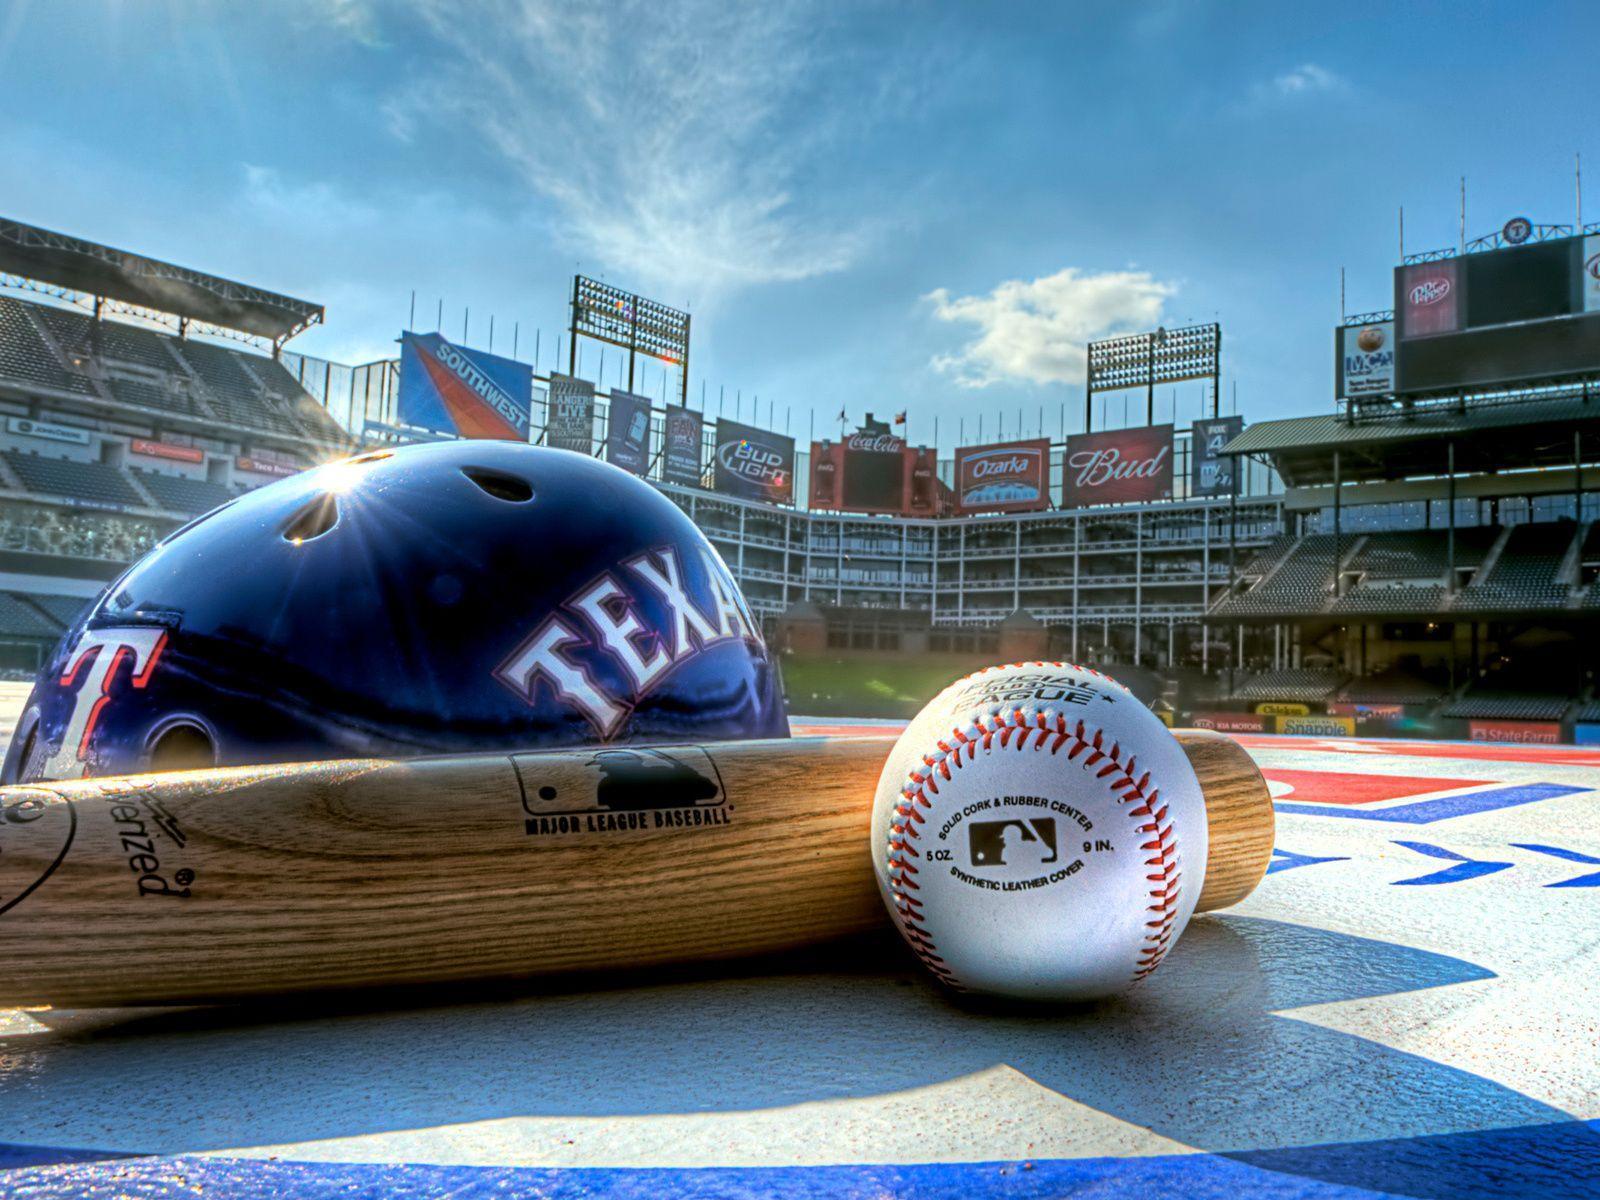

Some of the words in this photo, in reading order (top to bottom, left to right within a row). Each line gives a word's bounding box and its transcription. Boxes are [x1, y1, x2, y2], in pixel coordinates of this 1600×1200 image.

[436, 343, 528, 429] SOUTHWEST
[557, 403, 586, 417] LIVE
[253, 462, 273, 472] Taco
[735, 442, 783, 467] BUD
[973, 456, 1029, 478] Ozarka
[1069, 445, 1169, 488] Bud
[725, 456, 790, 481] LIGHT
[491, 543, 759, 744] TEXA
[44, 627, 169, 779] T
[1216, 722, 1230, 730] KIA
[1231, 723, 1263, 732] MOTORS
[1284, 718, 1347, 737] Snapple
[525, 816, 581, 835] MAJOR
[587, 812, 648, 832] LEAGUE
[654, 808, 731, 829] BASEBALL
[938, 812, 963, 841] SOLID
[963, 799, 992, 817] CORK
[993, 798, 1001, 808] &
[1003, 795, 1049, 809] RUBBER
[1050, 799, 1094, 833] CENTER
[926, 850, 934, 862] 5
[935, 850, 954, 862] OZ.
[1082, 841, 1092, 853] 9
[1095, 840, 1115, 852] IN.
[950, 866, 1001, 891] SYNTHETIC
[1002, 877, 1050, 892] LEATHER
[1050, 859, 1085, 884] COVER
